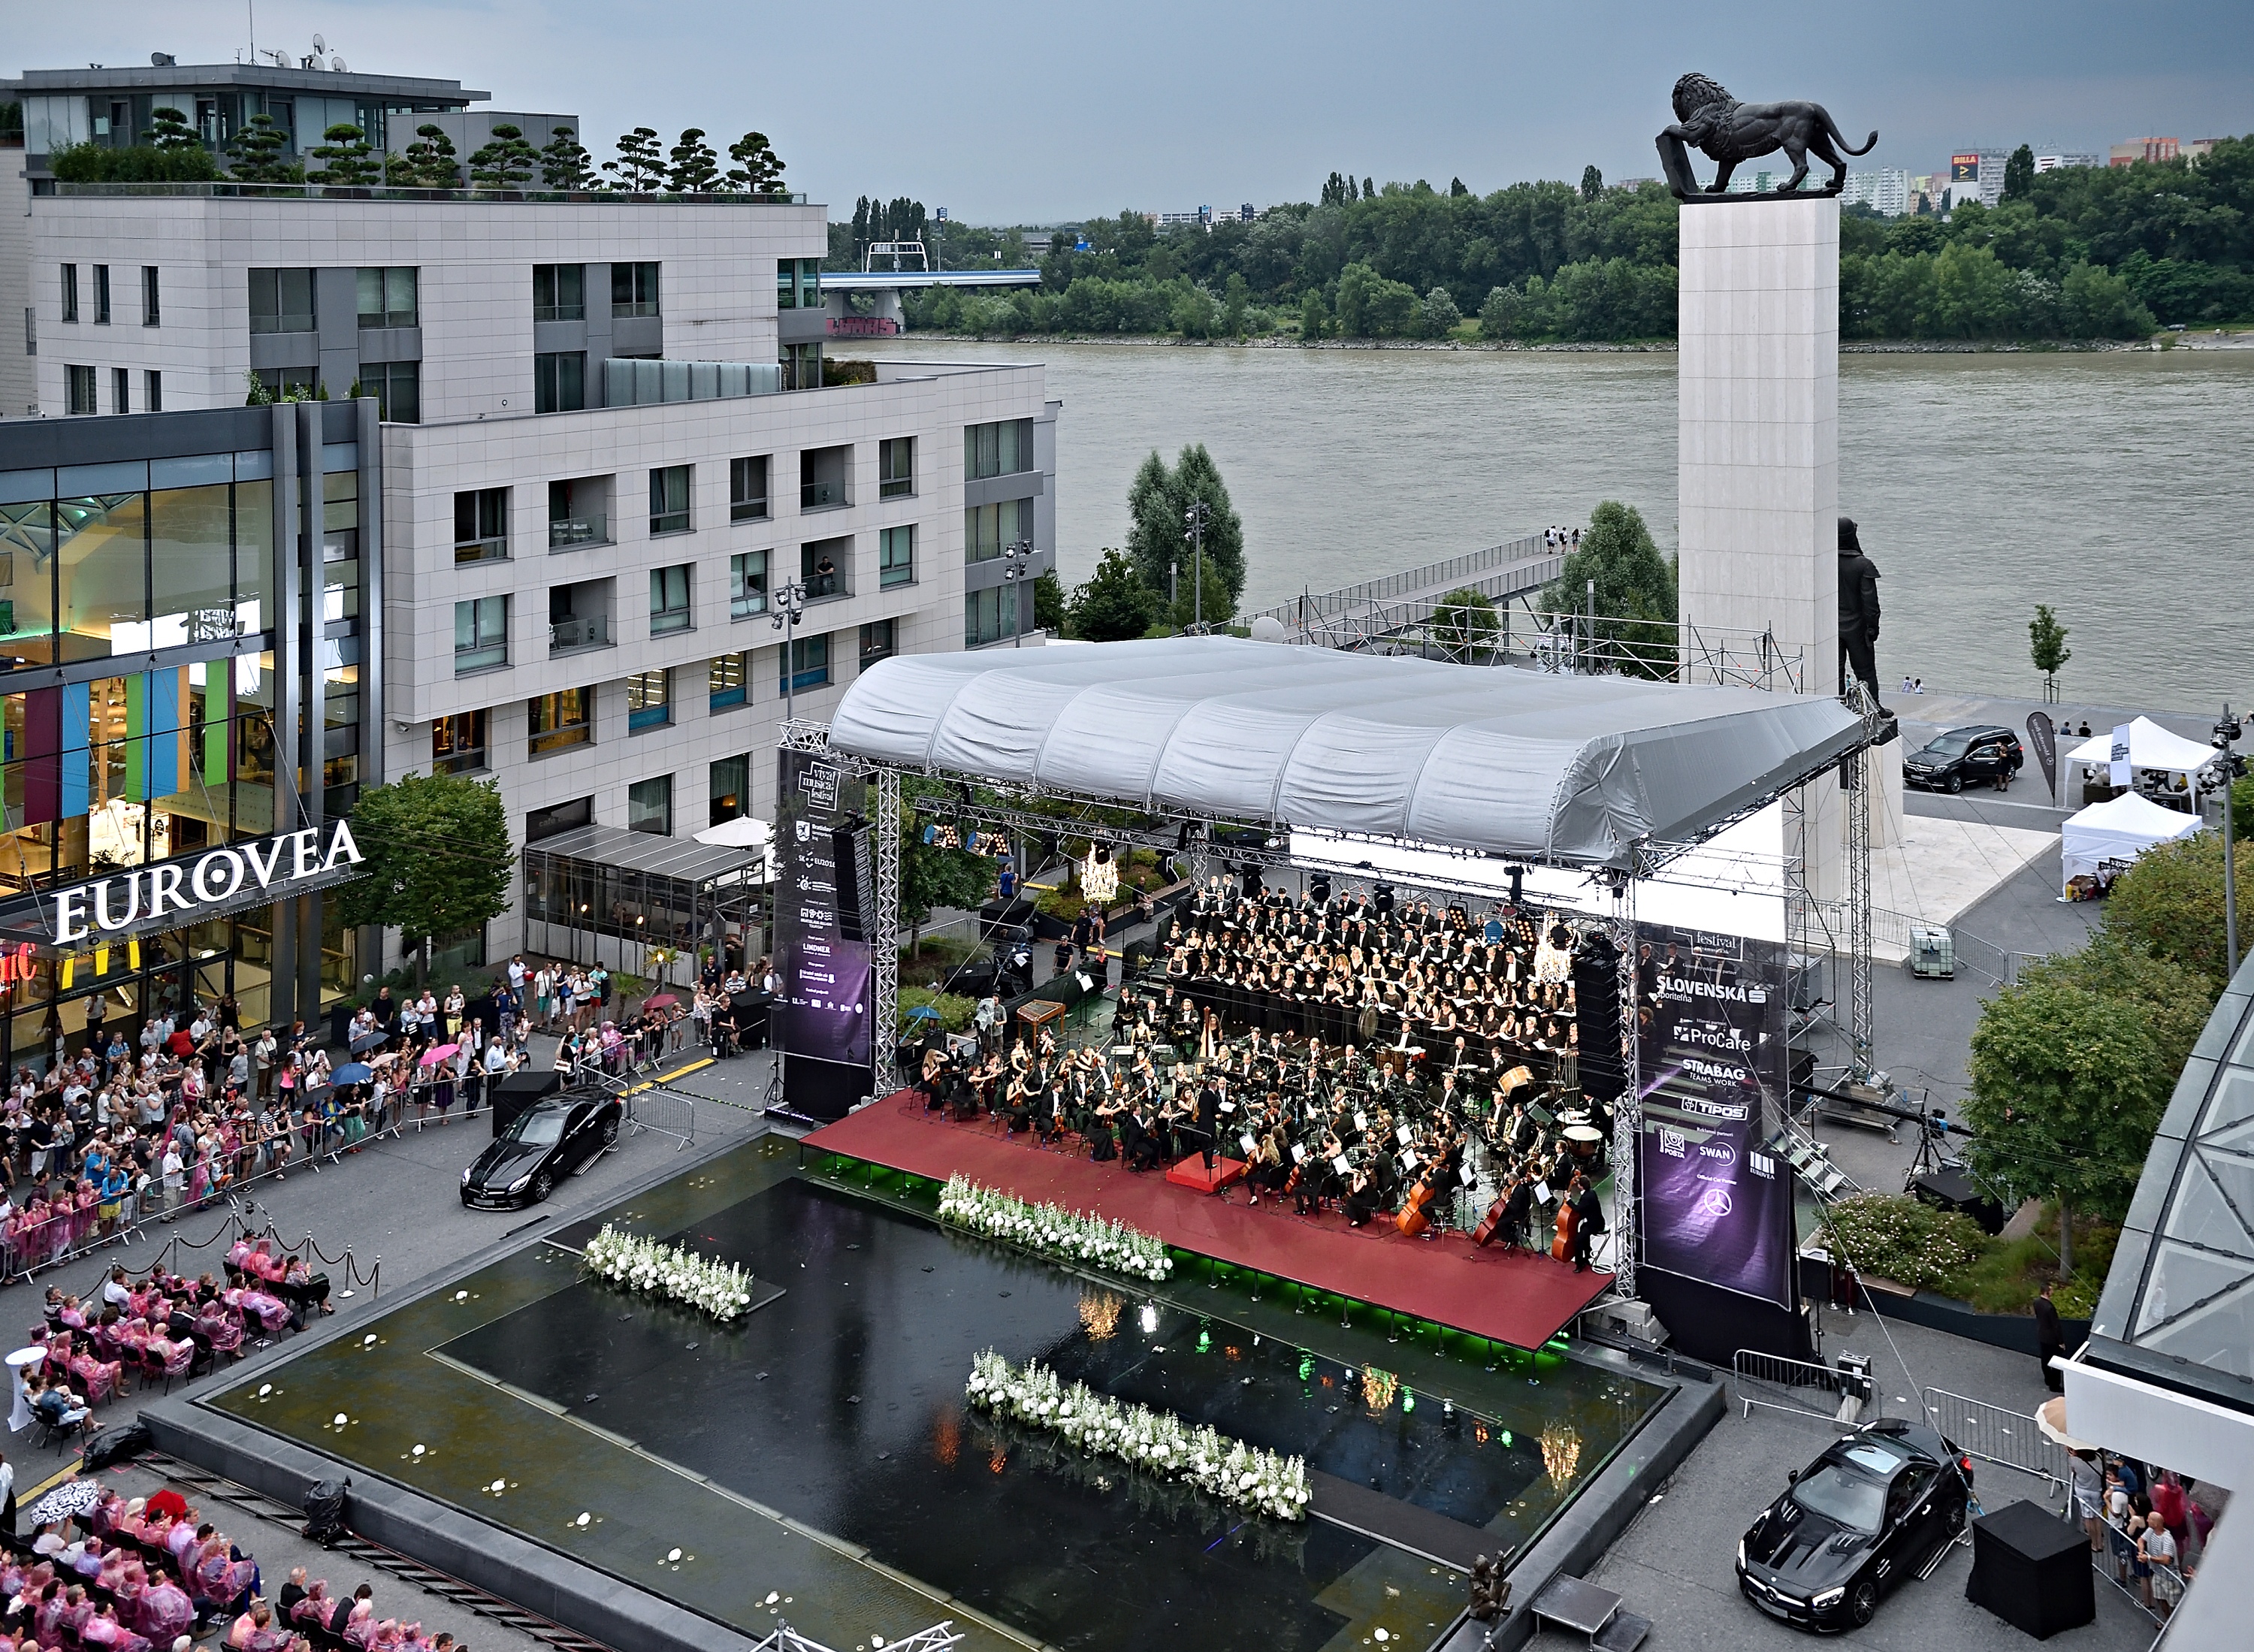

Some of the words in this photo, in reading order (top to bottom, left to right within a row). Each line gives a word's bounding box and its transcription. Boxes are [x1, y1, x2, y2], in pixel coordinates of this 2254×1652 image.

[1953, 156, 1976, 164] BILLA
[798, 854, 805, 862] SK
[50, 819, 366, 945] EUROVEA
[1697, 931, 1736, 949] festival
[802, 943, 831, 954] LINDNER
[1656, 975, 1747, 1003] SLOVENSKÁ
[1690, 1028, 1751, 1051] ProCare
[1682, 1059, 1746, 1080] STRABAG
[1690, 1072, 1712, 1083] TEAMS
[1714, 1078, 1739, 1088] WORK.
[1699, 1103, 1744, 1118] TIPOS
[1699, 1146, 1730, 1160] SWAN
